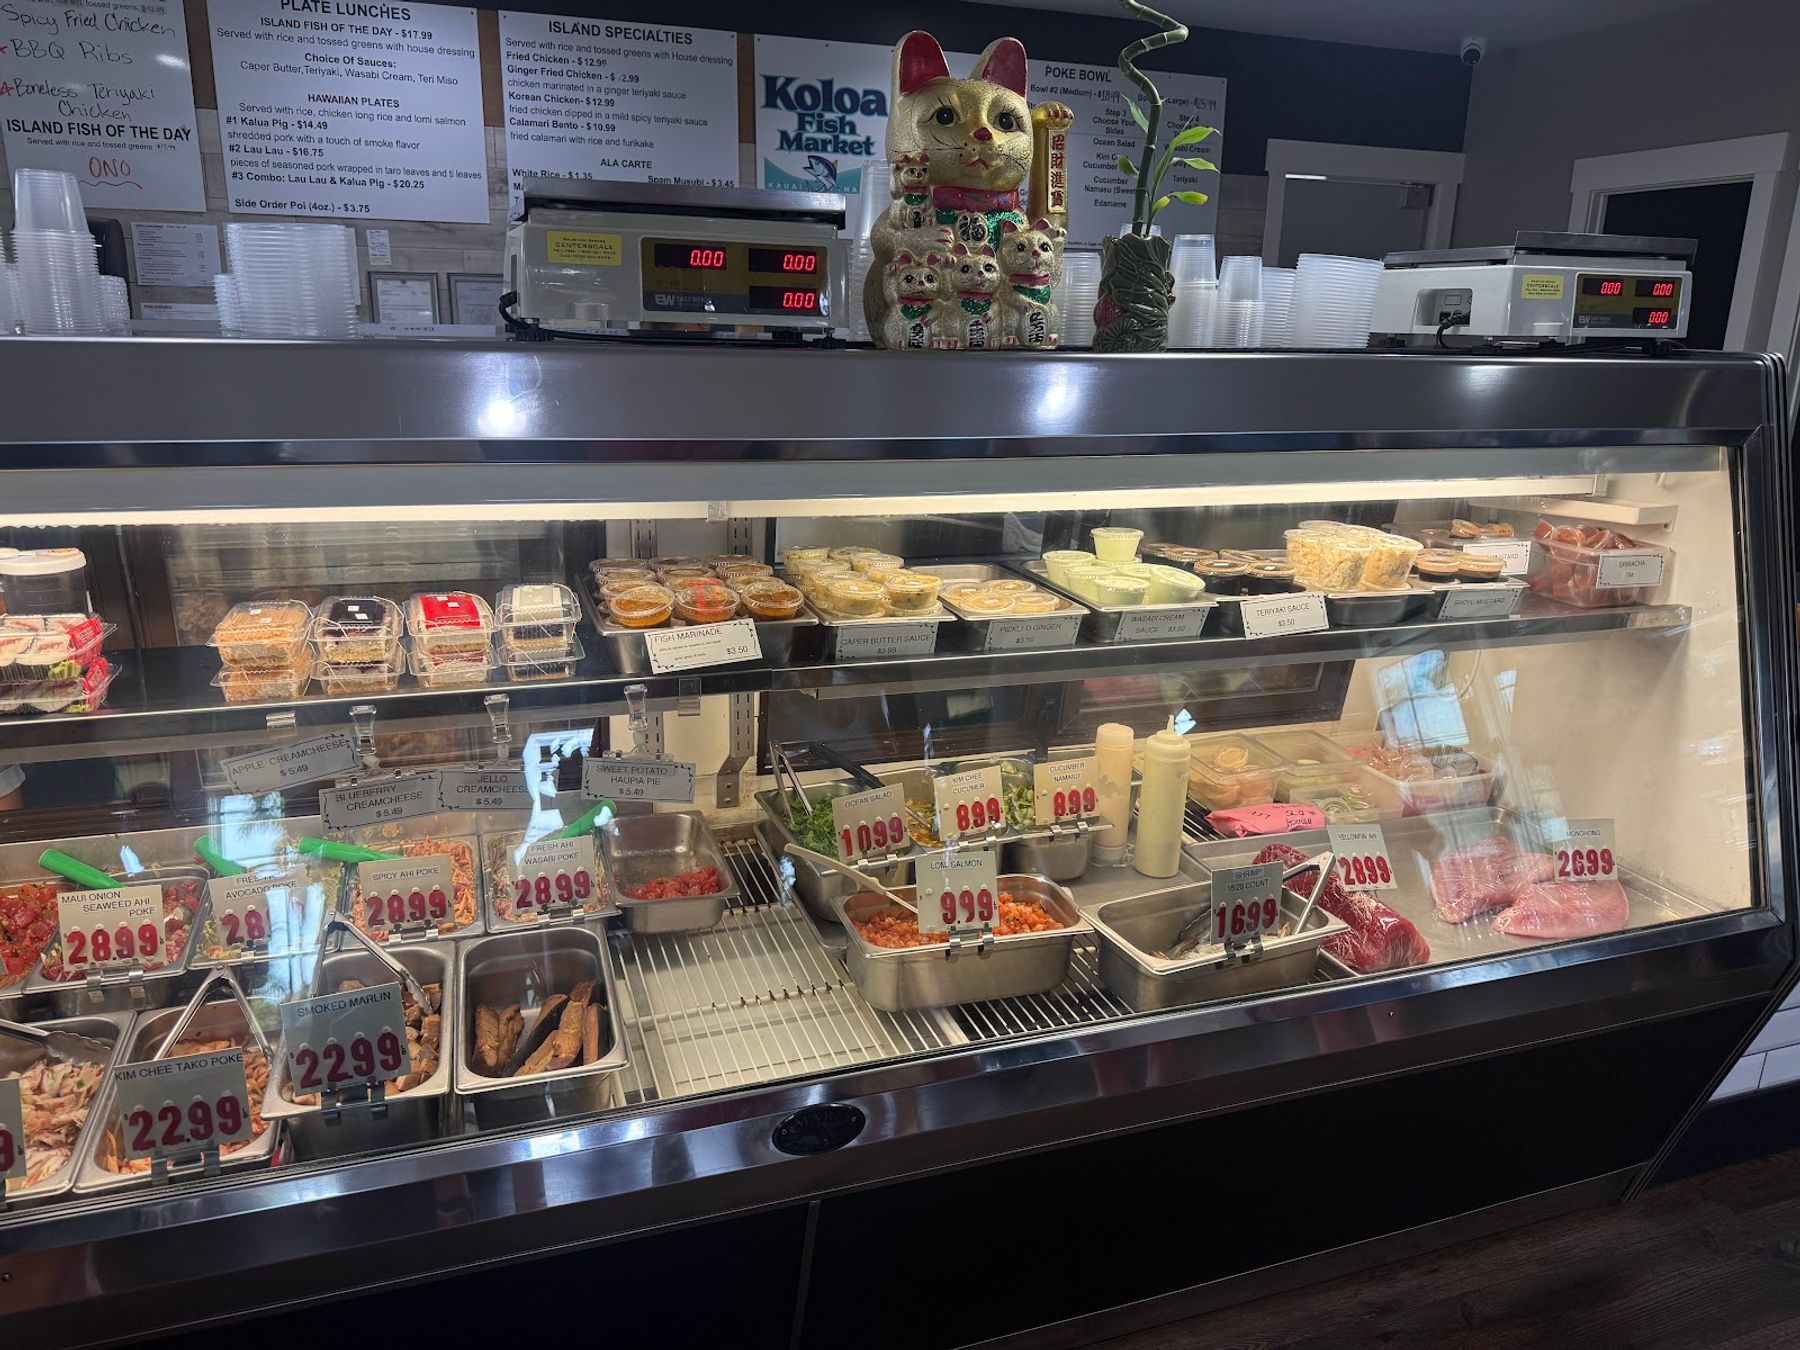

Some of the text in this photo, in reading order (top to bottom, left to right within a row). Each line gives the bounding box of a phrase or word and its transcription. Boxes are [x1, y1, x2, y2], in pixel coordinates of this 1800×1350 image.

[280, 0, 411, 20] PLATE LUNCHES
[1, 3, 175, 38] Spicy Fried Chicken
[261, 17, 433, 40] ISLAND FISH OF THE DAY $17.99
[548, 20, 693, 45] ISLAND SPECIALTIES
[10, 39, 133, 64] BBQ Ribs
[507, 51, 569, 65] Fried Chicken
[304, 53, 397, 68] Choice Of Sauces:
[1045, 65, 1112, 83] POKE BOWL
[13, 78, 158, 105] Boneless Teriyaki
[760, 73, 888, 117] Koloa
[1031, 84, 1092, 97] Bowl #2 (Medium)
[308, 94, 400, 108] HAWAIIAN PLATES
[58, 100, 132, 122] Chicken
[6, 119, 191, 141] ISLAND FISH OF THE DAY
[226, 116, 328, 130] #1 Kalua Pig $14.49
[510, 117, 615, 132] Calamari Bento $10.99
[793, 112, 861, 136] Fish
[775, 129, 877, 155] Market
[1093, 138, 1135, 148] Ocean Salad
[229, 144, 324, 157] #2 Lau Lau $16.75
[88, 156, 131, 177] ONO
[600, 159, 652, 170] ALA CARTE
[1093, 176, 1128, 185] Cucumber
[1172, 175, 1198, 184] Teriyaki
[235, 199, 257, 208] Side
[259, 200, 287, 210] Order
[290, 201, 306, 210] Poi
[344, 204, 370, 213] $3.75
[1094, 200, 1127, 209] Edamame
[690, 249, 725, 267] 0.00
[783, 254, 815, 271] 0.00
[1600, 282, 1621, 295] 0.00
[1653, 283, 1673, 296] 0.00
[783, 292, 815, 308] 0.00
[1649, 311, 1669, 324] 0.00
[1256, 602, 1310, 617] TERIYAKI SAUCE
[1277, 618, 1295, 627] $3.50
[654, 627, 722, 643] FISH MARINADE
[727, 645, 748, 655] $3.50
[232, 740, 347, 776] APPLE CREAMCHEESE
[597, 765, 668, 776] SWEET POTATO
[1049, 763, 1085, 773] CUCUMBER
[478, 774, 507, 784] JELLO
[611, 776, 661, 786] HAUPIA PIE
[952, 774, 964, 784] KIM
[336, 785, 397, 802] BLUEBERRY
[346, 791, 423, 811] CREAMCHEESE
[845, 791, 892, 808] OCEAN SALAD
[1054, 787, 1095, 817] 8.99
[560, 841, 574, 850] AHI
[524, 852, 579, 866] WASABI POKE
[951, 860, 982, 869] SALMON
[1558, 848, 1613, 877] 26.99
[373, 868, 439, 881] SPICY AHI POKE
[1235, 869, 1262, 879] SHRIMP
[1339, 855, 1391, 886] 28.99
[514, 870, 591, 909] 28.99
[1246, 879, 1269, 889] COUNT
[61, 890, 121, 905] MAUI ONION
[83, 898, 150, 913] SEAWEED AHI
[129, 907, 155, 916] POKE
[366, 889, 447, 926] 28.99
[940, 889, 993, 924] 9.99
[1216, 896, 1276, 939] 16.99
[66, 922, 158, 965] 28.99
[297, 991, 392, 1017] SMOKED MARLIN
[115, 1053, 242, 1082] KIM CHEE TAKO POKE
[295, 1031, 402, 1089] 22.99
[128, 1095, 243, 1150] 22.99
